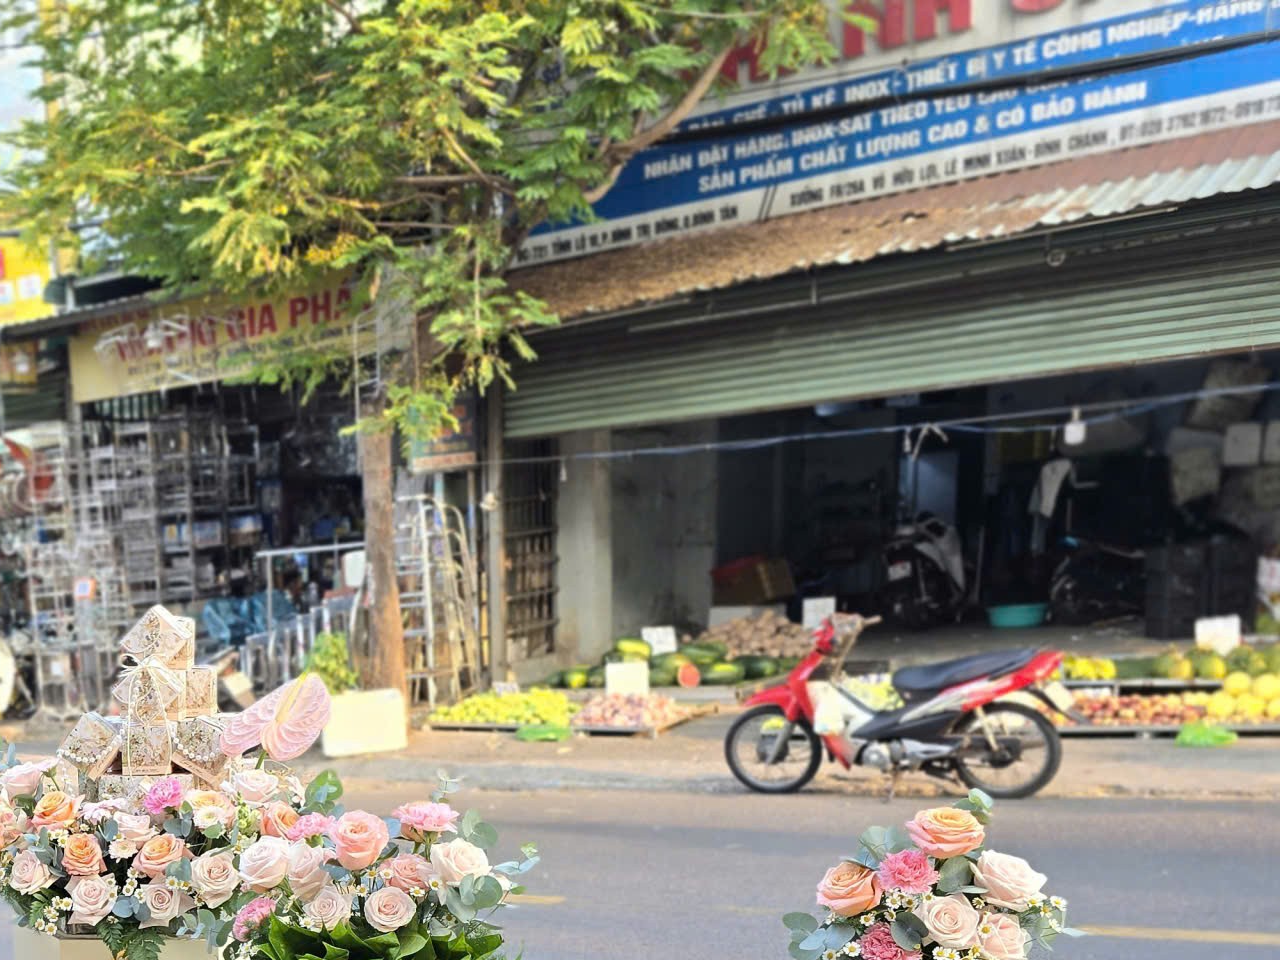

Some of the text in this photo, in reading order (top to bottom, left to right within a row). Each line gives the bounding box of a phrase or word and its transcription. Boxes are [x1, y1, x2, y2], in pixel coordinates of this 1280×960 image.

[992, 52, 1006, 71] Y
[1041, 27, 1103, 59] CÔNG
[927, 118, 970, 144] CAO
[973, 114, 990, 134] &
[1030, 93, 1076, 123] BẢO
